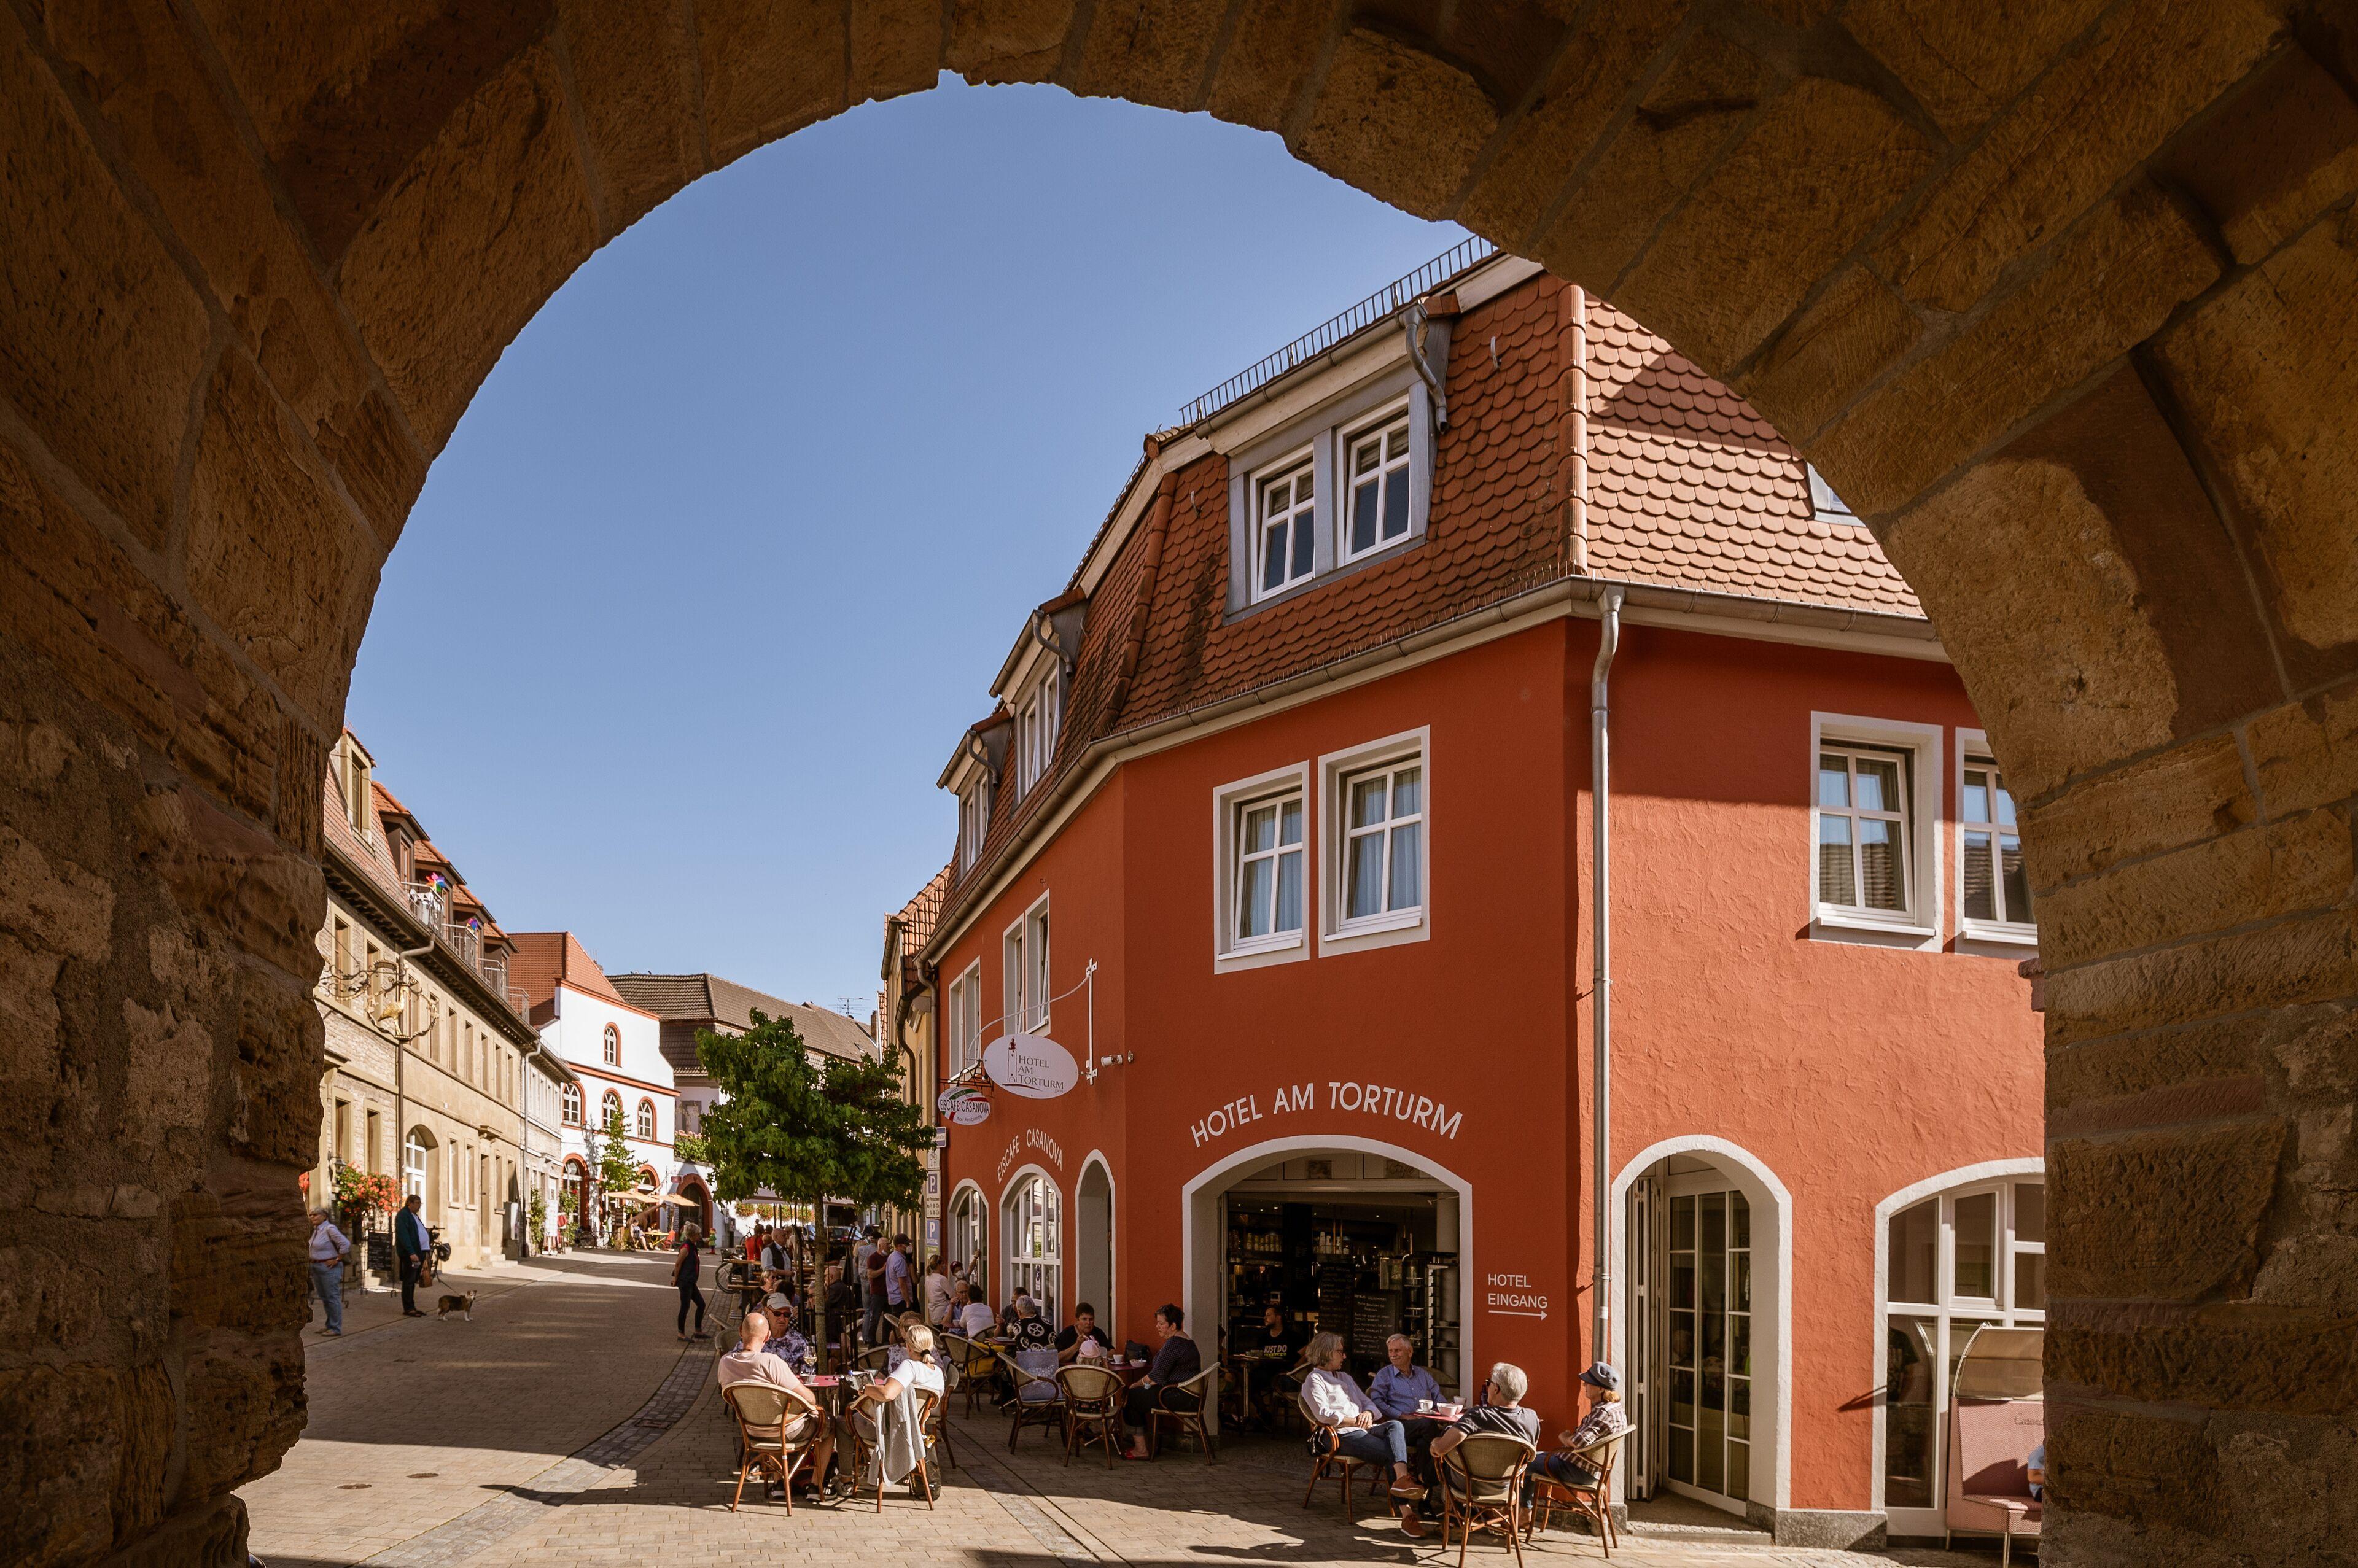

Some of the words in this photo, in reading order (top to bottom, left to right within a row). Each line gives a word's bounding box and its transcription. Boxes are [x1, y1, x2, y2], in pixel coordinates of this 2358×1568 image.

[1018, 1055, 1049, 1068] HOTEL
[1018, 1066, 1033, 1075] AM
[1018, 1074, 1064, 1090] TORTURM
[961, 1101, 989, 1114] CASANOVA
[1190, 1094, 1263, 1148] HOTEL
[1273, 1082, 1313, 1114] AM
[1328, 1081, 1463, 1140] TORTURM
[997, 1135, 1019, 1184] EISCAFE
[1026, 1128, 1063, 1171] CASANOVA
[929, 1221, 936, 1238] P
[1488, 1273, 1531, 1288] HOTEL
[1488, 1292, 1548, 1309] EINGANG
